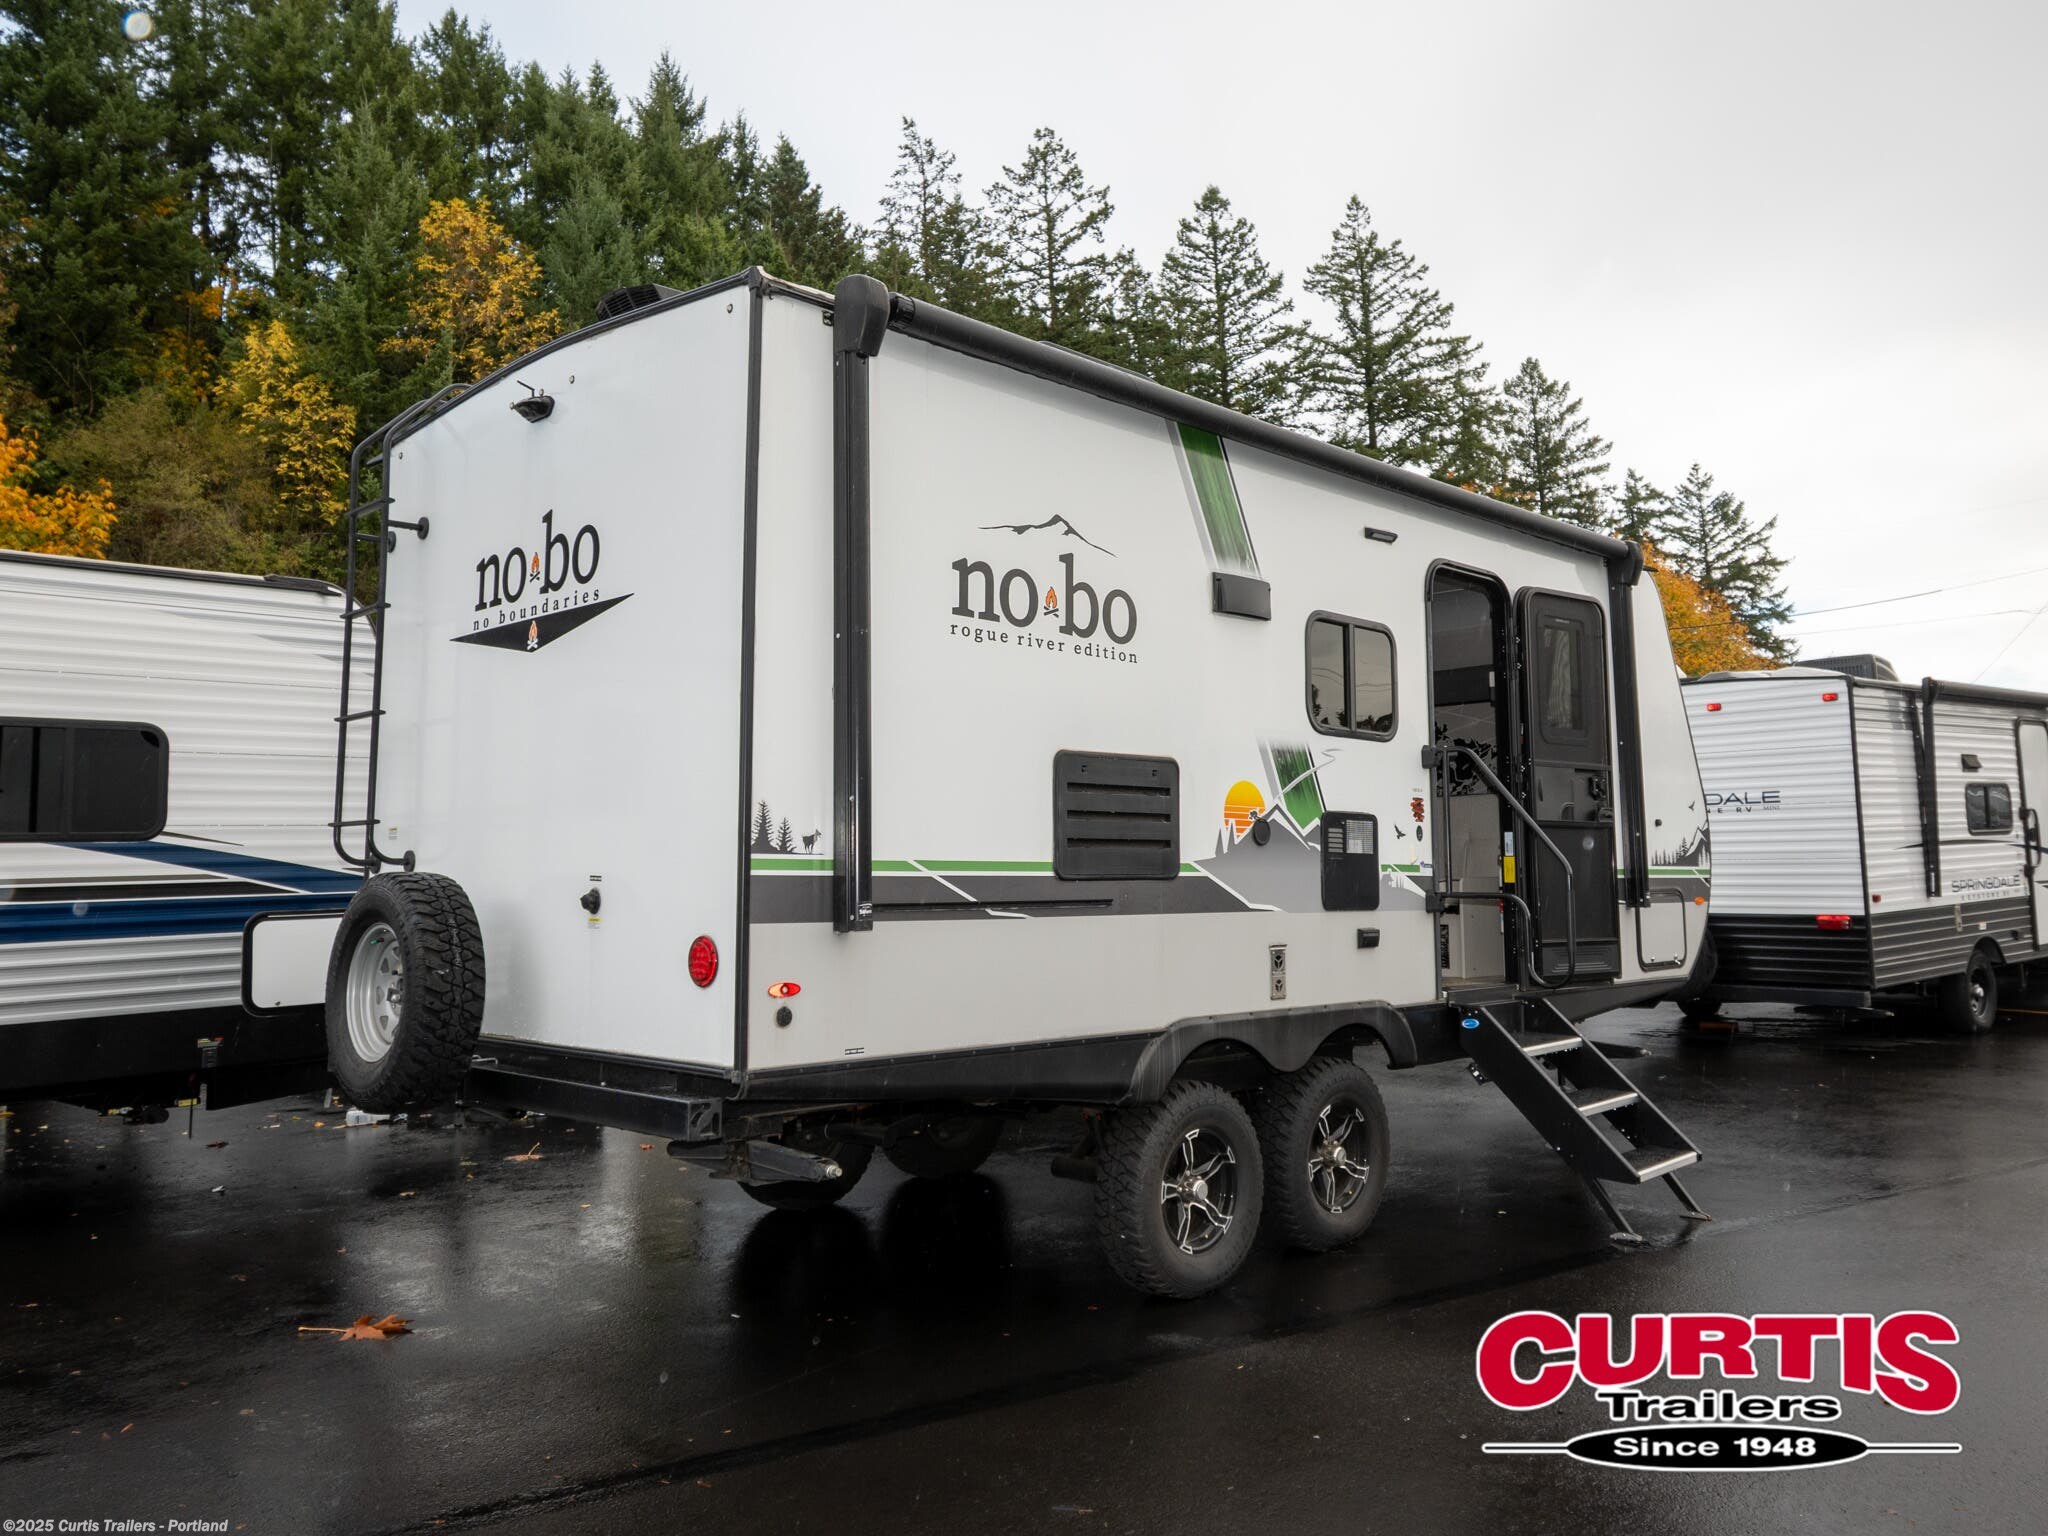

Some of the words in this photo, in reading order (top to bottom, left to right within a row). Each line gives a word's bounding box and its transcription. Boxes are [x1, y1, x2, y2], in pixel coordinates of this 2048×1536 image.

[473, 617, 489, 631] no
[499, 589, 600, 624] boundaries
[950, 623, 1009, 643] rogue
[1017, 632, 1065, 652] river
[1074, 642, 1138, 663] edition
[1952, 875, 2020, 893] SPRINGDALE
